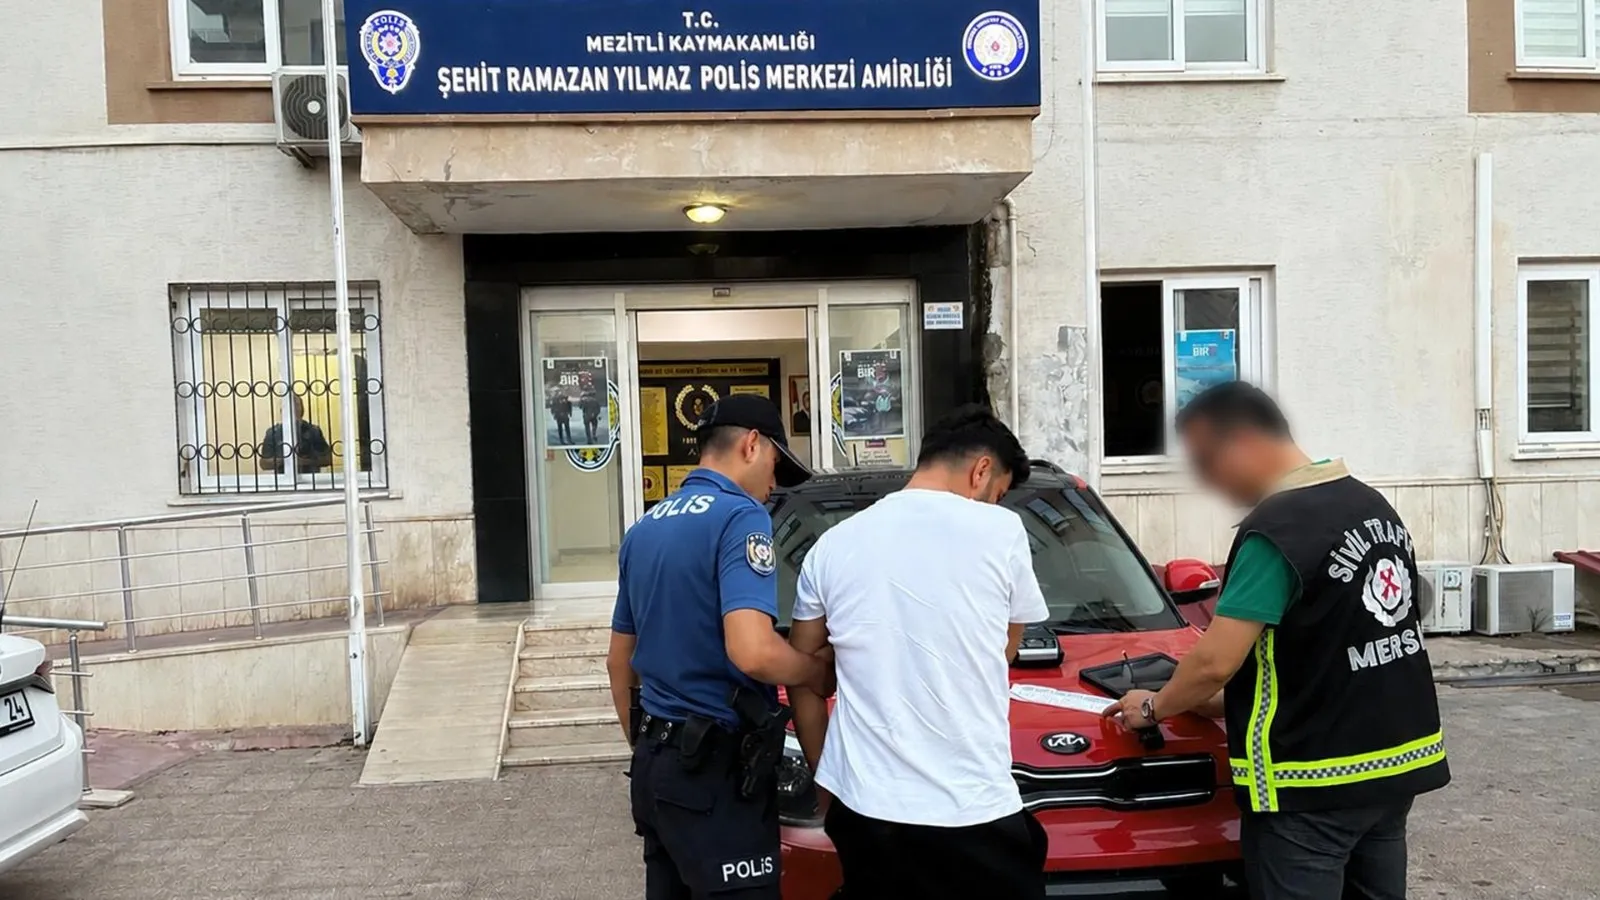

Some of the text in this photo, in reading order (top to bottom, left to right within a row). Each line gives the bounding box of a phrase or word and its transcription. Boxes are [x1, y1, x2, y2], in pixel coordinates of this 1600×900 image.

[682, 11, 719, 29] T.C.
[586, 31, 815, 53] MEZİTLİ KAYMAKAMLIĞI
[437, 61, 501, 98] ŞEHİT
[506, 66, 609, 93] RAMAZAN
[613, 65, 692, 92] YILMAZ
[700, 59, 761, 90] POLİS
[765, 58, 856, 90] MERKEZİ
[861, 56, 953, 89] AMİRLİĞİ
[1328, 528, 1372, 583] SİVİL
[4, 696, 25, 721] 24
